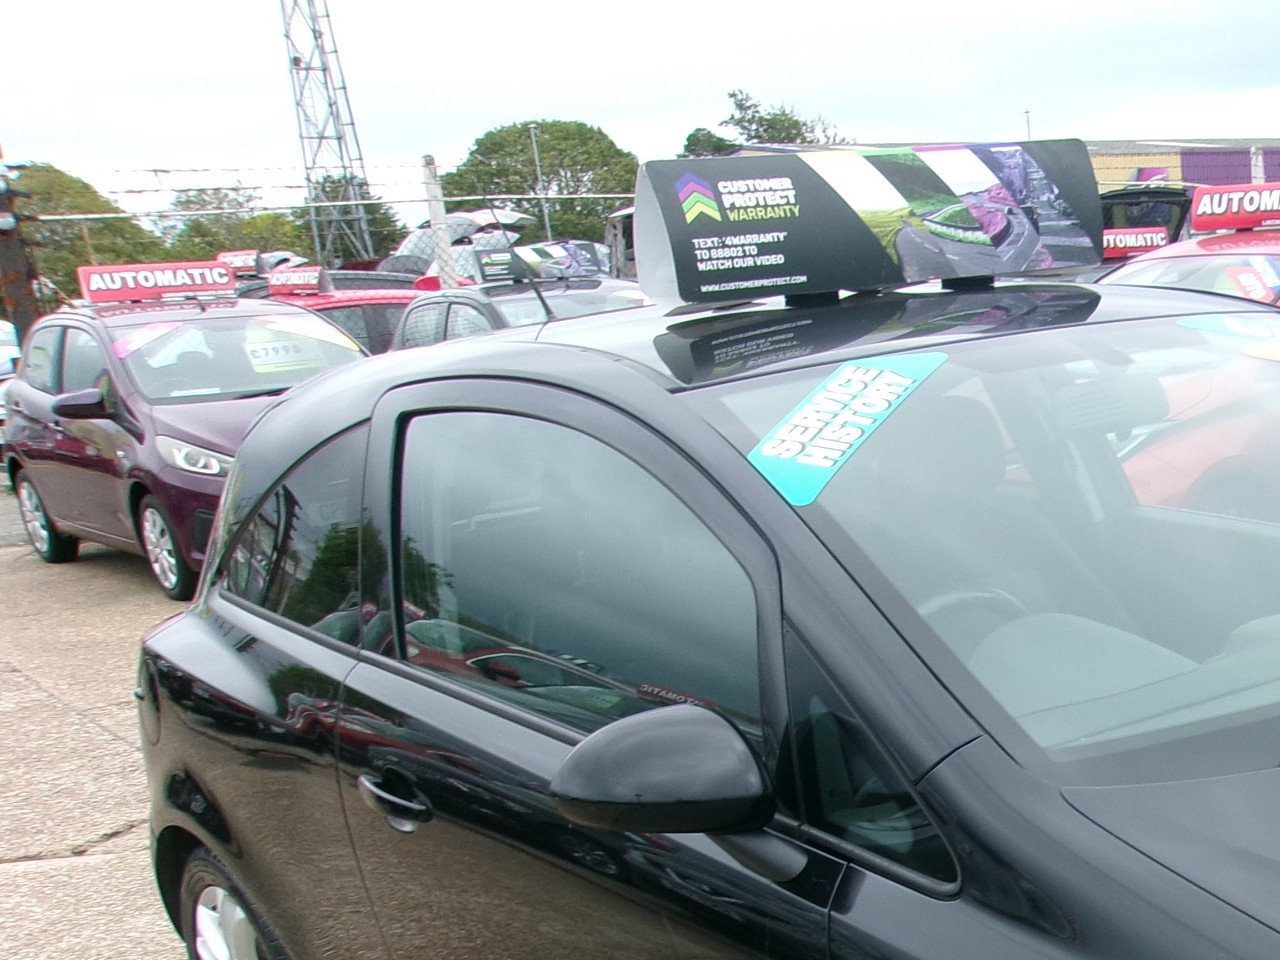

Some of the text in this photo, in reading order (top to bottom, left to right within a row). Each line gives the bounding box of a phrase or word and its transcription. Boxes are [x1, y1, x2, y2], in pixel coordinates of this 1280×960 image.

[717, 177, 794, 193] CUSTOMER
[721, 190, 797, 208] PROTECT
[726, 205, 800, 221] WARRANTY
[694, 250, 709, 260] TO
[743, 245, 758, 255] TO
[696, 254, 785, 271] WATCH OUR VIDEO
[88, 266, 230, 291] AUTOMATIC
[760, 365, 885, 460] SERVICE
[795, 370, 917, 469] HISTORY
